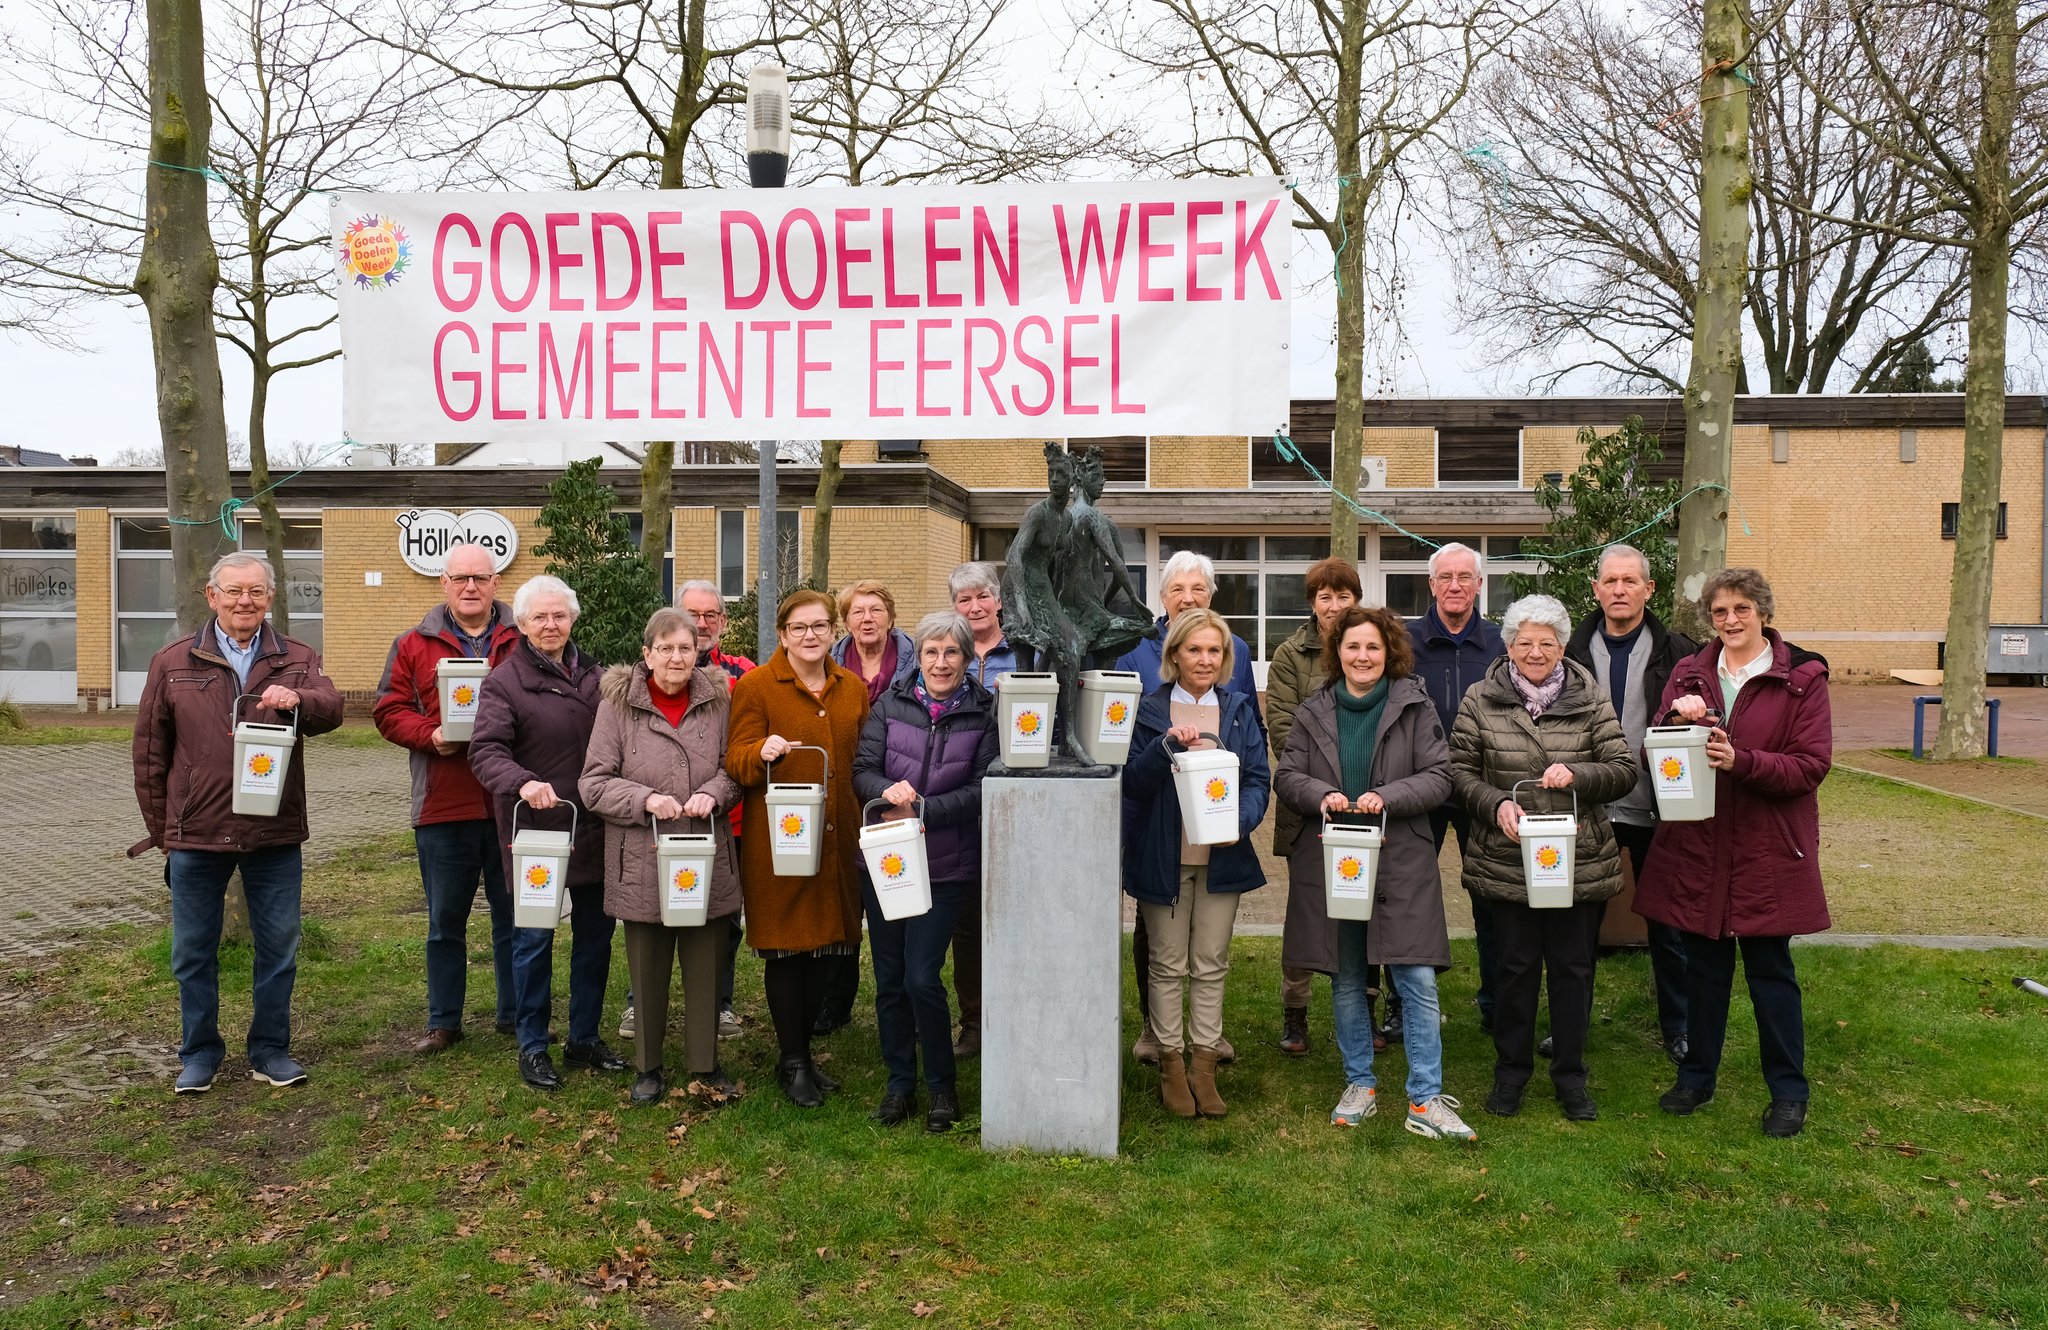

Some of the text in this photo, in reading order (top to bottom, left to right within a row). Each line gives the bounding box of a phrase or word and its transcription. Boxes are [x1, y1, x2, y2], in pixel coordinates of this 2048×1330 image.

[354, 233, 390, 249] Goede
[355, 246, 394, 261] Doelen
[433, 199, 1282, 313] GOEDE DOELEN WEEK
[361, 257, 391, 272] Week
[434, 313, 1146, 423] GEMEENTE EERSEL
[396, 510, 420, 529] De
